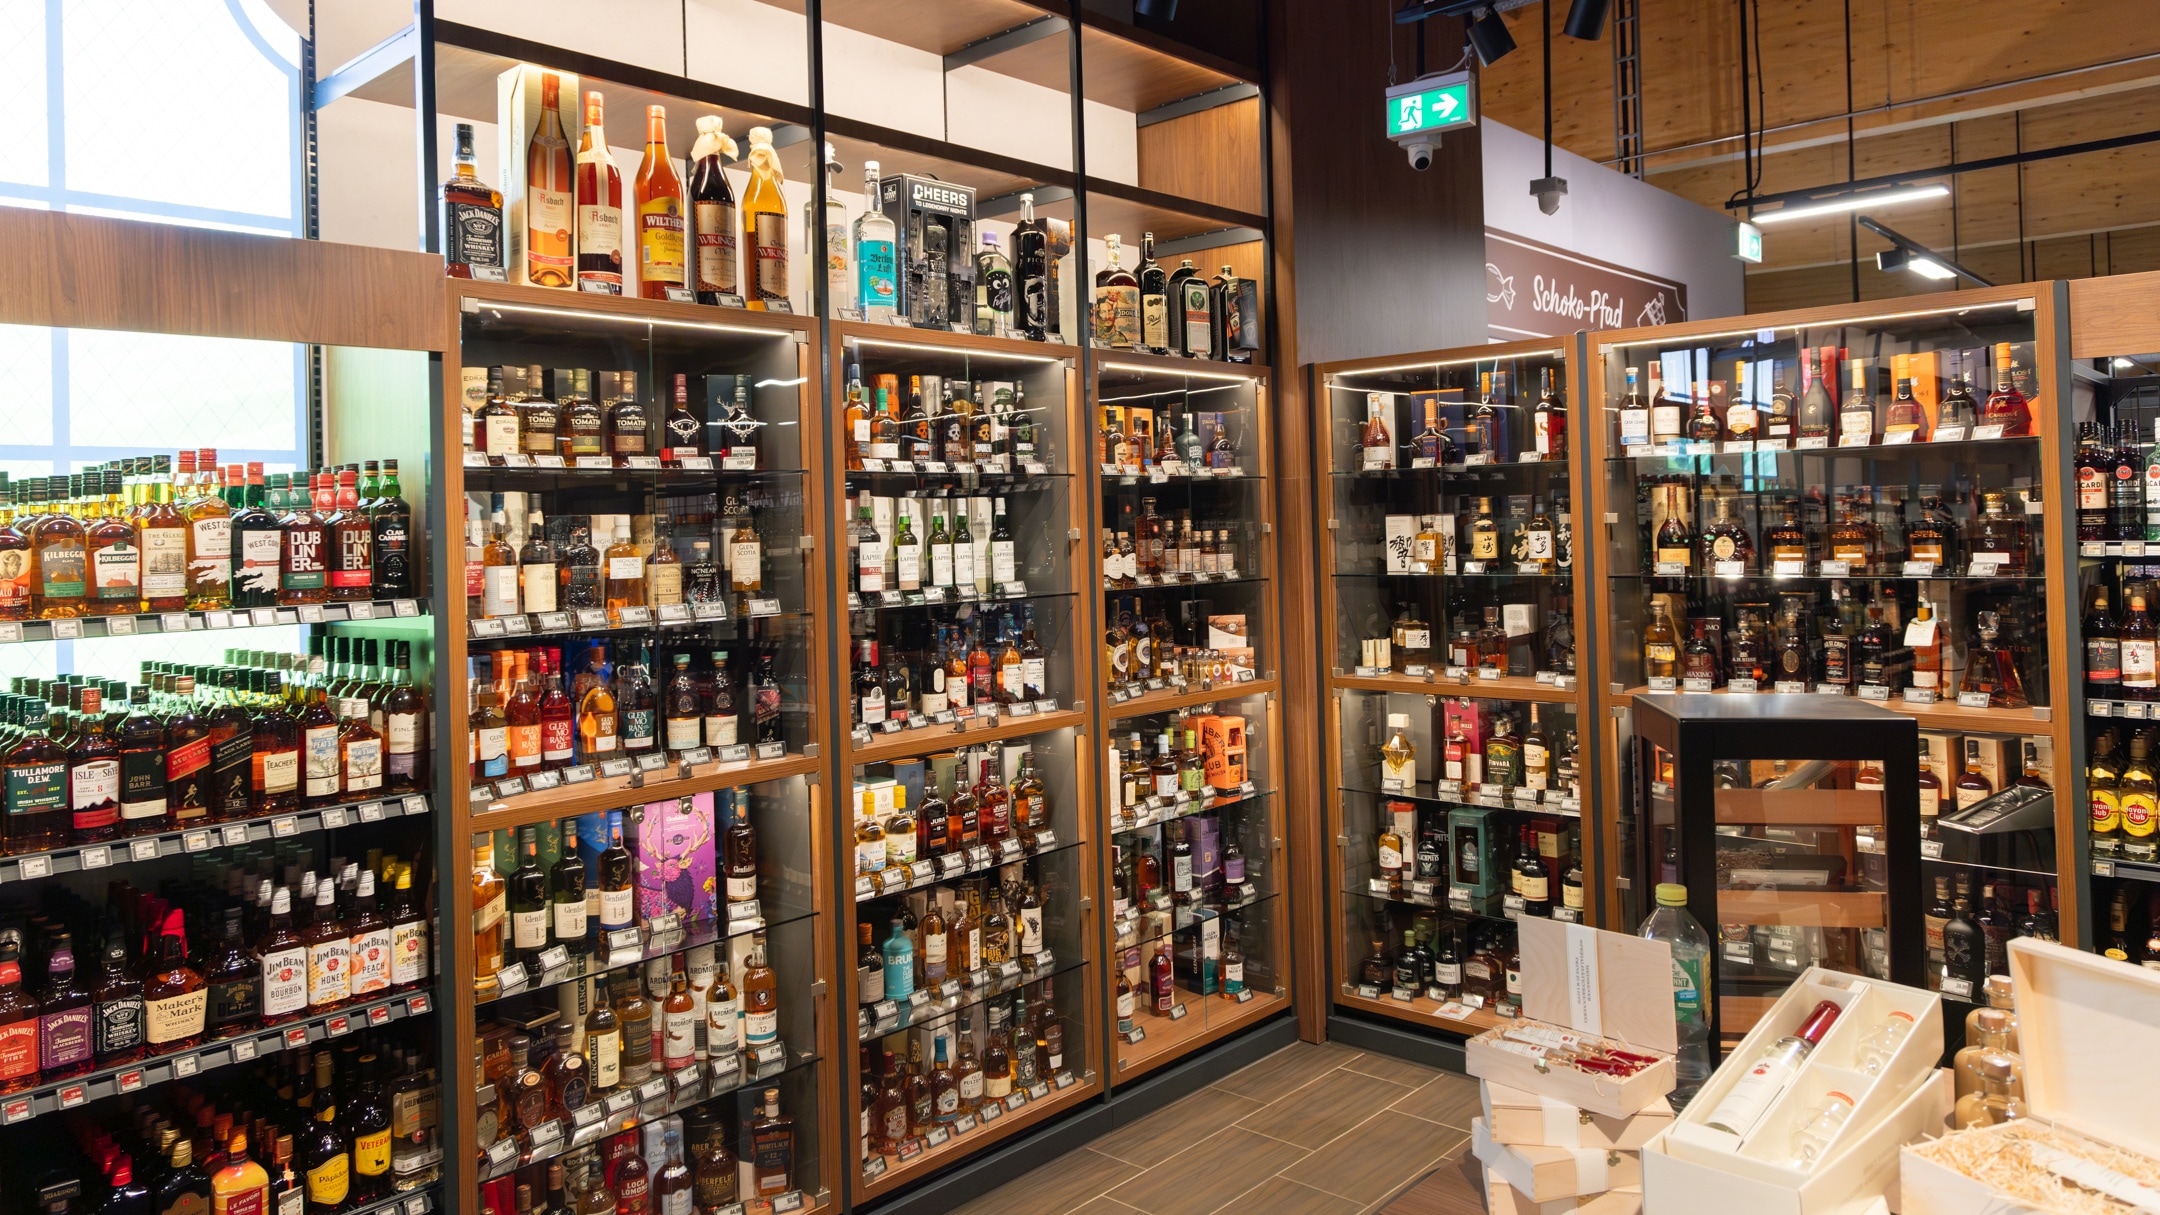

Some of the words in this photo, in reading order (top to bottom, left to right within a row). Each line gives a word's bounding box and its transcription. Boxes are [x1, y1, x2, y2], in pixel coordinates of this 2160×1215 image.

[539, 192, 564, 207] Asbach
[912, 184, 968, 207] CHEERS
[923, 201, 949, 211] LEGENDARY
[950, 206, 968, 215] NIGHTS
[459, 210, 475, 221] JACK
[592, 210, 618, 226] Asbach
[464, 243, 495, 252] WHISKEY
[1533, 274, 1624, 329] Schoko-Pfad
[528, 416, 556, 424] TOMATIN
[571, 418, 601, 426] TOMATIN
[199, 521, 220, 532] WEST
[290, 531, 322, 545] DUB
[342, 530, 371, 544] DUB
[385, 529, 405, 537] CLAN
[248, 540, 267, 550] WEST
[290, 543, 316, 558] LIN
[342, 543, 367, 557] LIN
[1719, 546, 1730, 554] XO
[291, 557, 311, 572] ER
[342, 556, 364, 571] ER
[627, 711, 647, 720] GLEN
[548, 721, 569, 731] GLEN
[628, 724, 643, 732] RAN
[556, 728, 569, 737] MO
[549, 736, 564, 744] RAN
[556, 742, 568, 750] GIE
[172, 755, 187, 766] RED
[266, 758, 297, 771] TEACHER'S
[1488, 759, 1510, 768] FINVARA
[12, 764, 65, 778] TULLAMORE
[75, 770, 95, 781] ISLE
[27, 775, 51, 784] D.E.W.
[128, 775, 151, 783] JOHN
[34, 795, 60, 804] WHISKEY
[1030, 796, 1043, 804] JURA
[993, 803, 1007, 812] JURA
[2092, 809, 2108, 817] Club
[962, 810, 977, 819] JURA
[2128, 812, 2147, 822] Club
[930, 817, 946, 825] JURA
[613, 908, 625, 919] 14
[394, 930, 410, 946] JIM
[409, 927, 427, 940] BEAM
[1204, 934, 1219, 942] MORAY
[355, 939, 371, 955] JIM
[371, 936, 389, 948] BEAM
[314, 949, 329, 966] JIM
[329, 946, 349, 960] BEAM
[987, 948, 1001, 957] BIG
[987, 954, 1003, 963] PEAT
[267, 959, 283, 976] JIM
[283, 956, 305, 969] BEAM
[362, 962, 385, 974] PEACH
[321, 972, 345, 985] HONEY
[270, 984, 303, 999] BOURBON
[102, 1004, 119, 1018] JACK
[118, 1000, 142, 1010] DANIEL'S
[155, 995, 204, 1013] Maker's
[169, 1004, 202, 1020] Mark
[713, 1005, 738, 1017] ARDMORE
[47, 1019, 63, 1031] JACK
[63, 1014, 89, 1024] DANIEL'S
[165, 1016, 196, 1028] WHISKY
[670, 1017, 694, 1028] ARDMORE
[8, 1027, 36, 1037] DANIEL'S
[107, 1027, 137, 1039] WHISKEY
[759, 1025, 768, 1033] 12
[52, 1037, 85, 1050] BLACKBERRY
[3, 1054, 25, 1064] FIRE
[626, 1178, 645, 1189] LOCH
[621, 1183, 648, 1196] LOMOND
[240, 1193, 261, 1208] FAVORI
